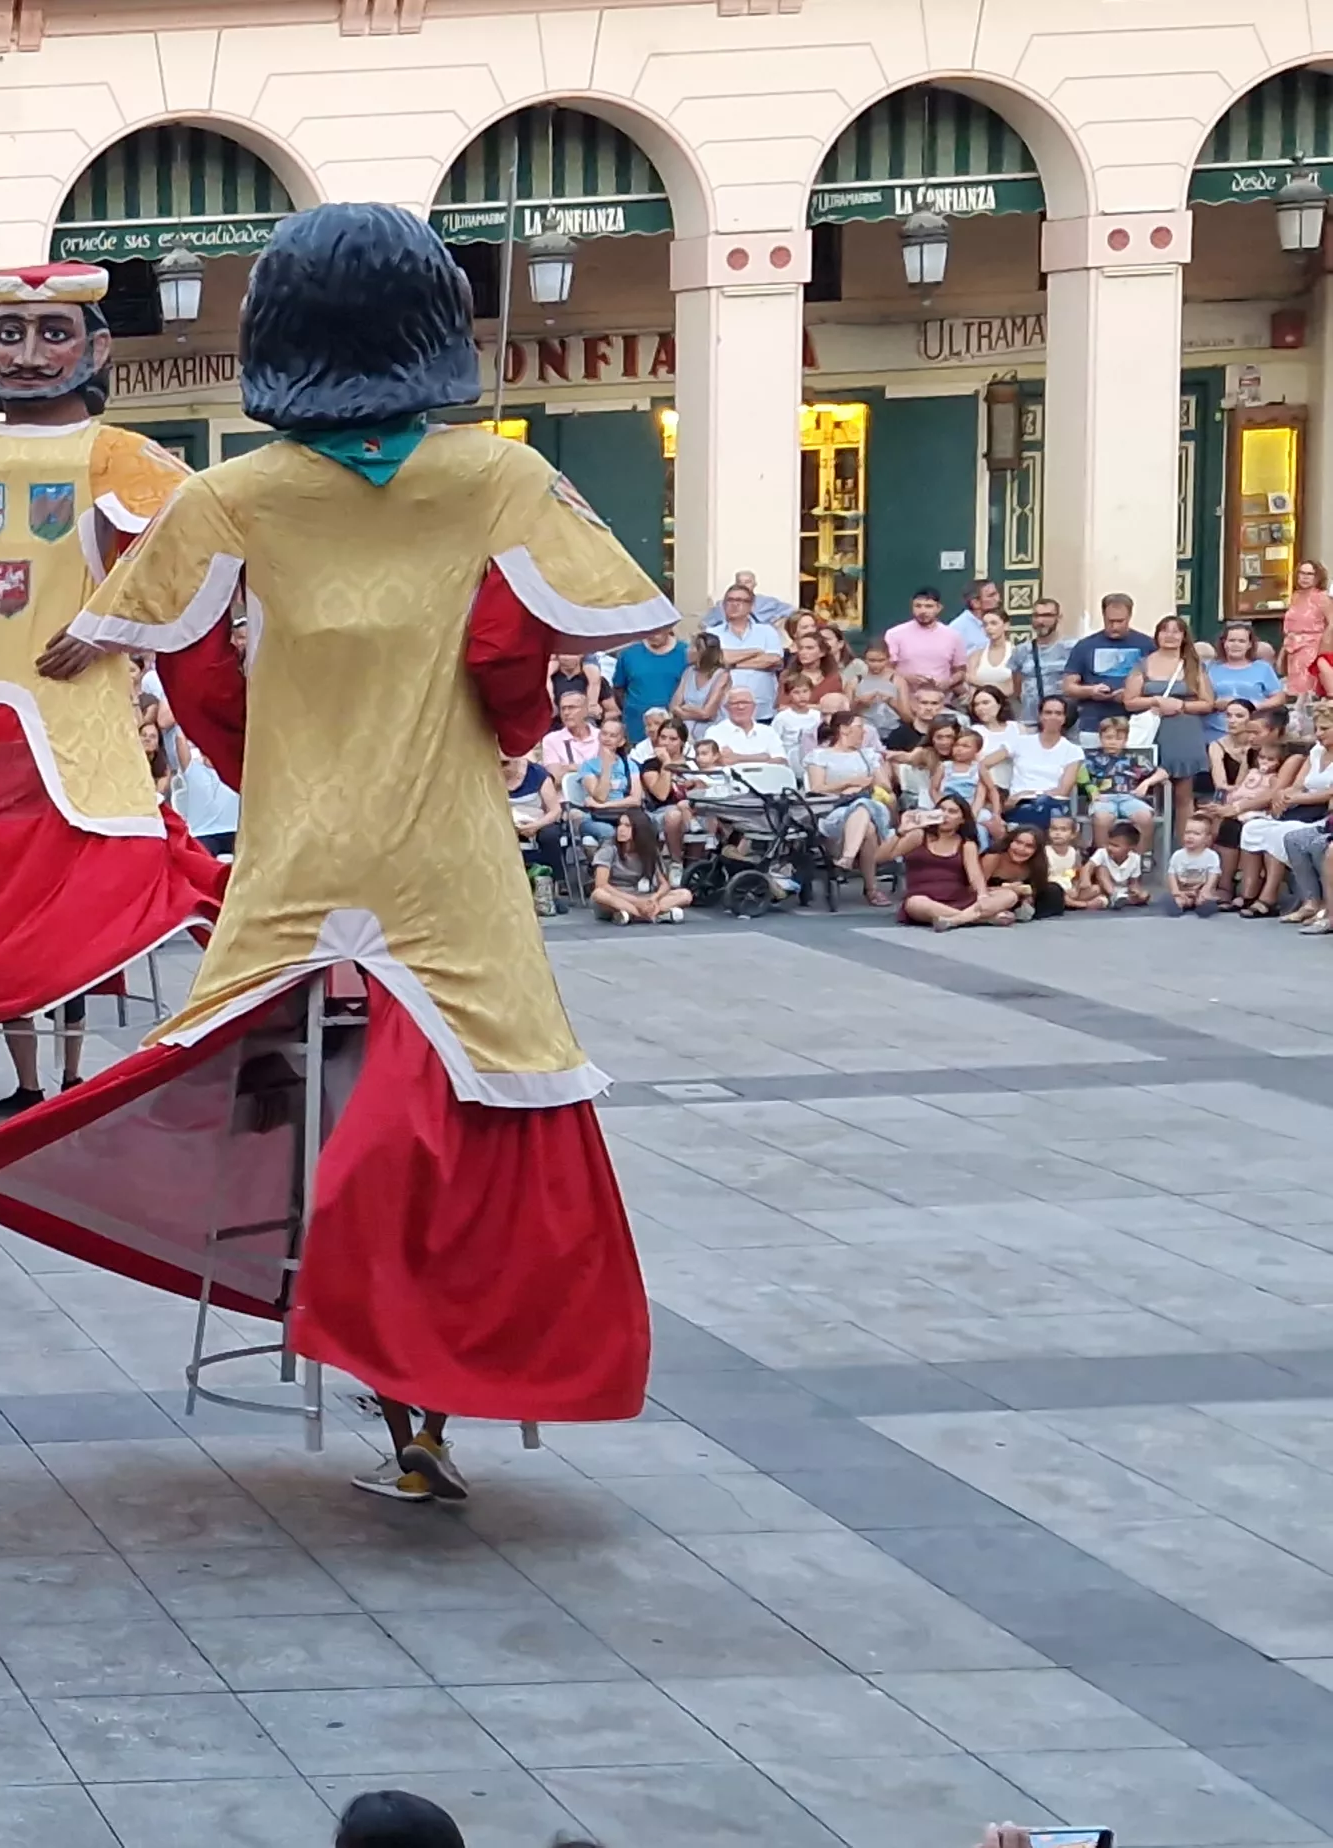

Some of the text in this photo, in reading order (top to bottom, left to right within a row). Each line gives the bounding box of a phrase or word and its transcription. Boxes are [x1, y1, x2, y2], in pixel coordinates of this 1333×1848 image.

[1231, 169, 1276, 191] desde
[895, 187, 913, 215] LA
[524, 208, 542, 236] LA
[124, 233, 151, 249] sus
[923, 313, 1046, 361] ULTRAMA
[113, 353, 240, 396] RAMARINO
